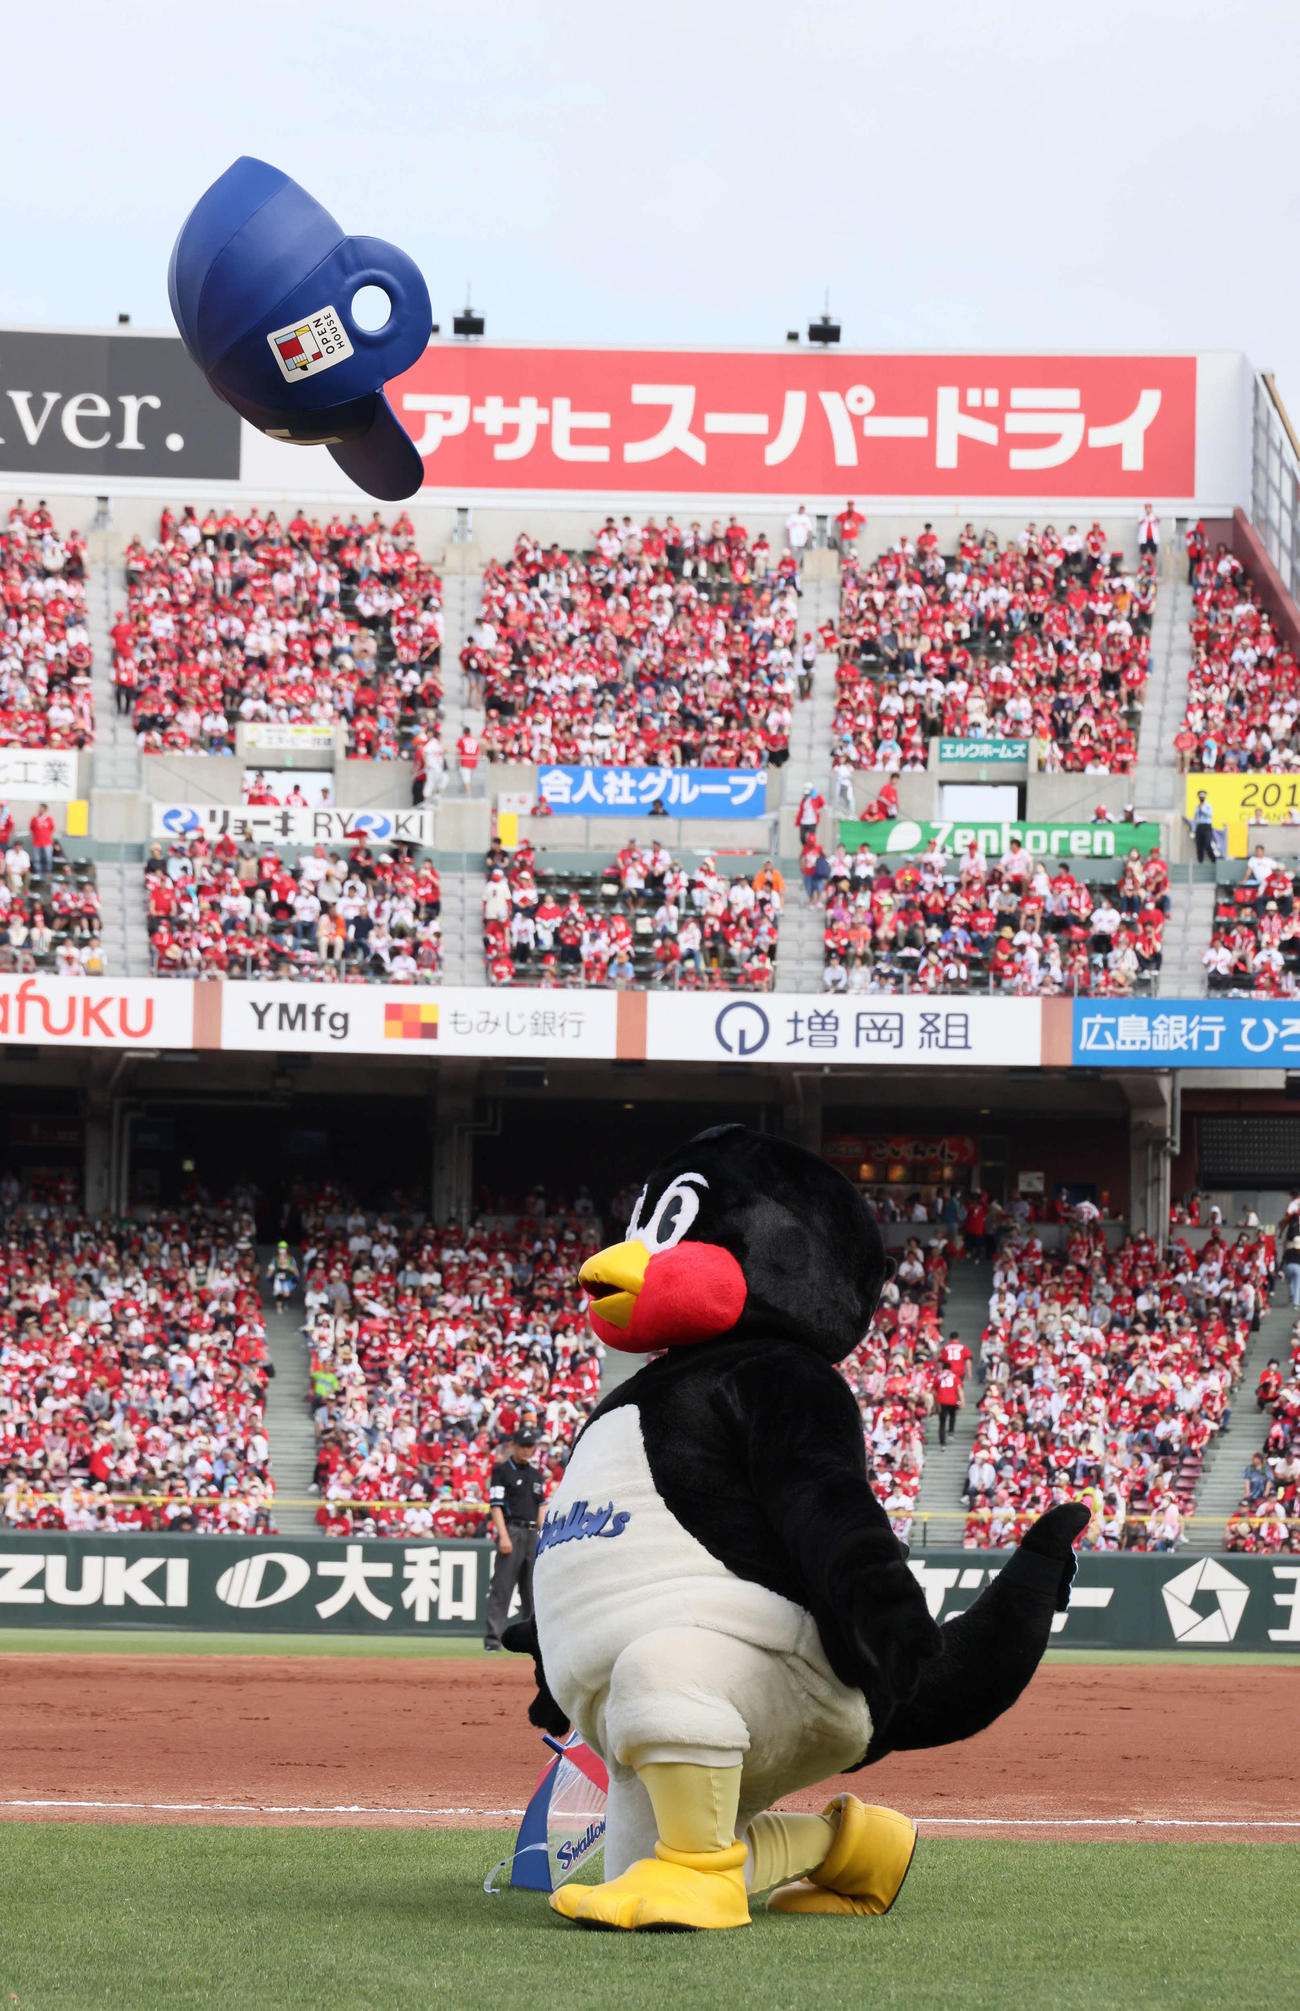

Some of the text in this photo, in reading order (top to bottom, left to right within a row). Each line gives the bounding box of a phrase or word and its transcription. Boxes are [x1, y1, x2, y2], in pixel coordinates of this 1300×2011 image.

[313, 318, 335, 354] OPEN
[324, 313, 345, 349] HOUSE
[0, 389, 184, 452] ver.
[403, 384, 1161, 471] アサヒスーパードライ
[539, 768, 768, 806] 合人社グループ
[209, 809, 295, 838] リョーキ
[250, 1002, 349, 1039] YMfg
[449, 1009, 586, 1039] もみじ銀行
[786, 1009, 972, 1050] 増岡組
[1079, 1013, 1226, 1052] 広島銀行
[0, 1553, 189, 1608] ZUKI
